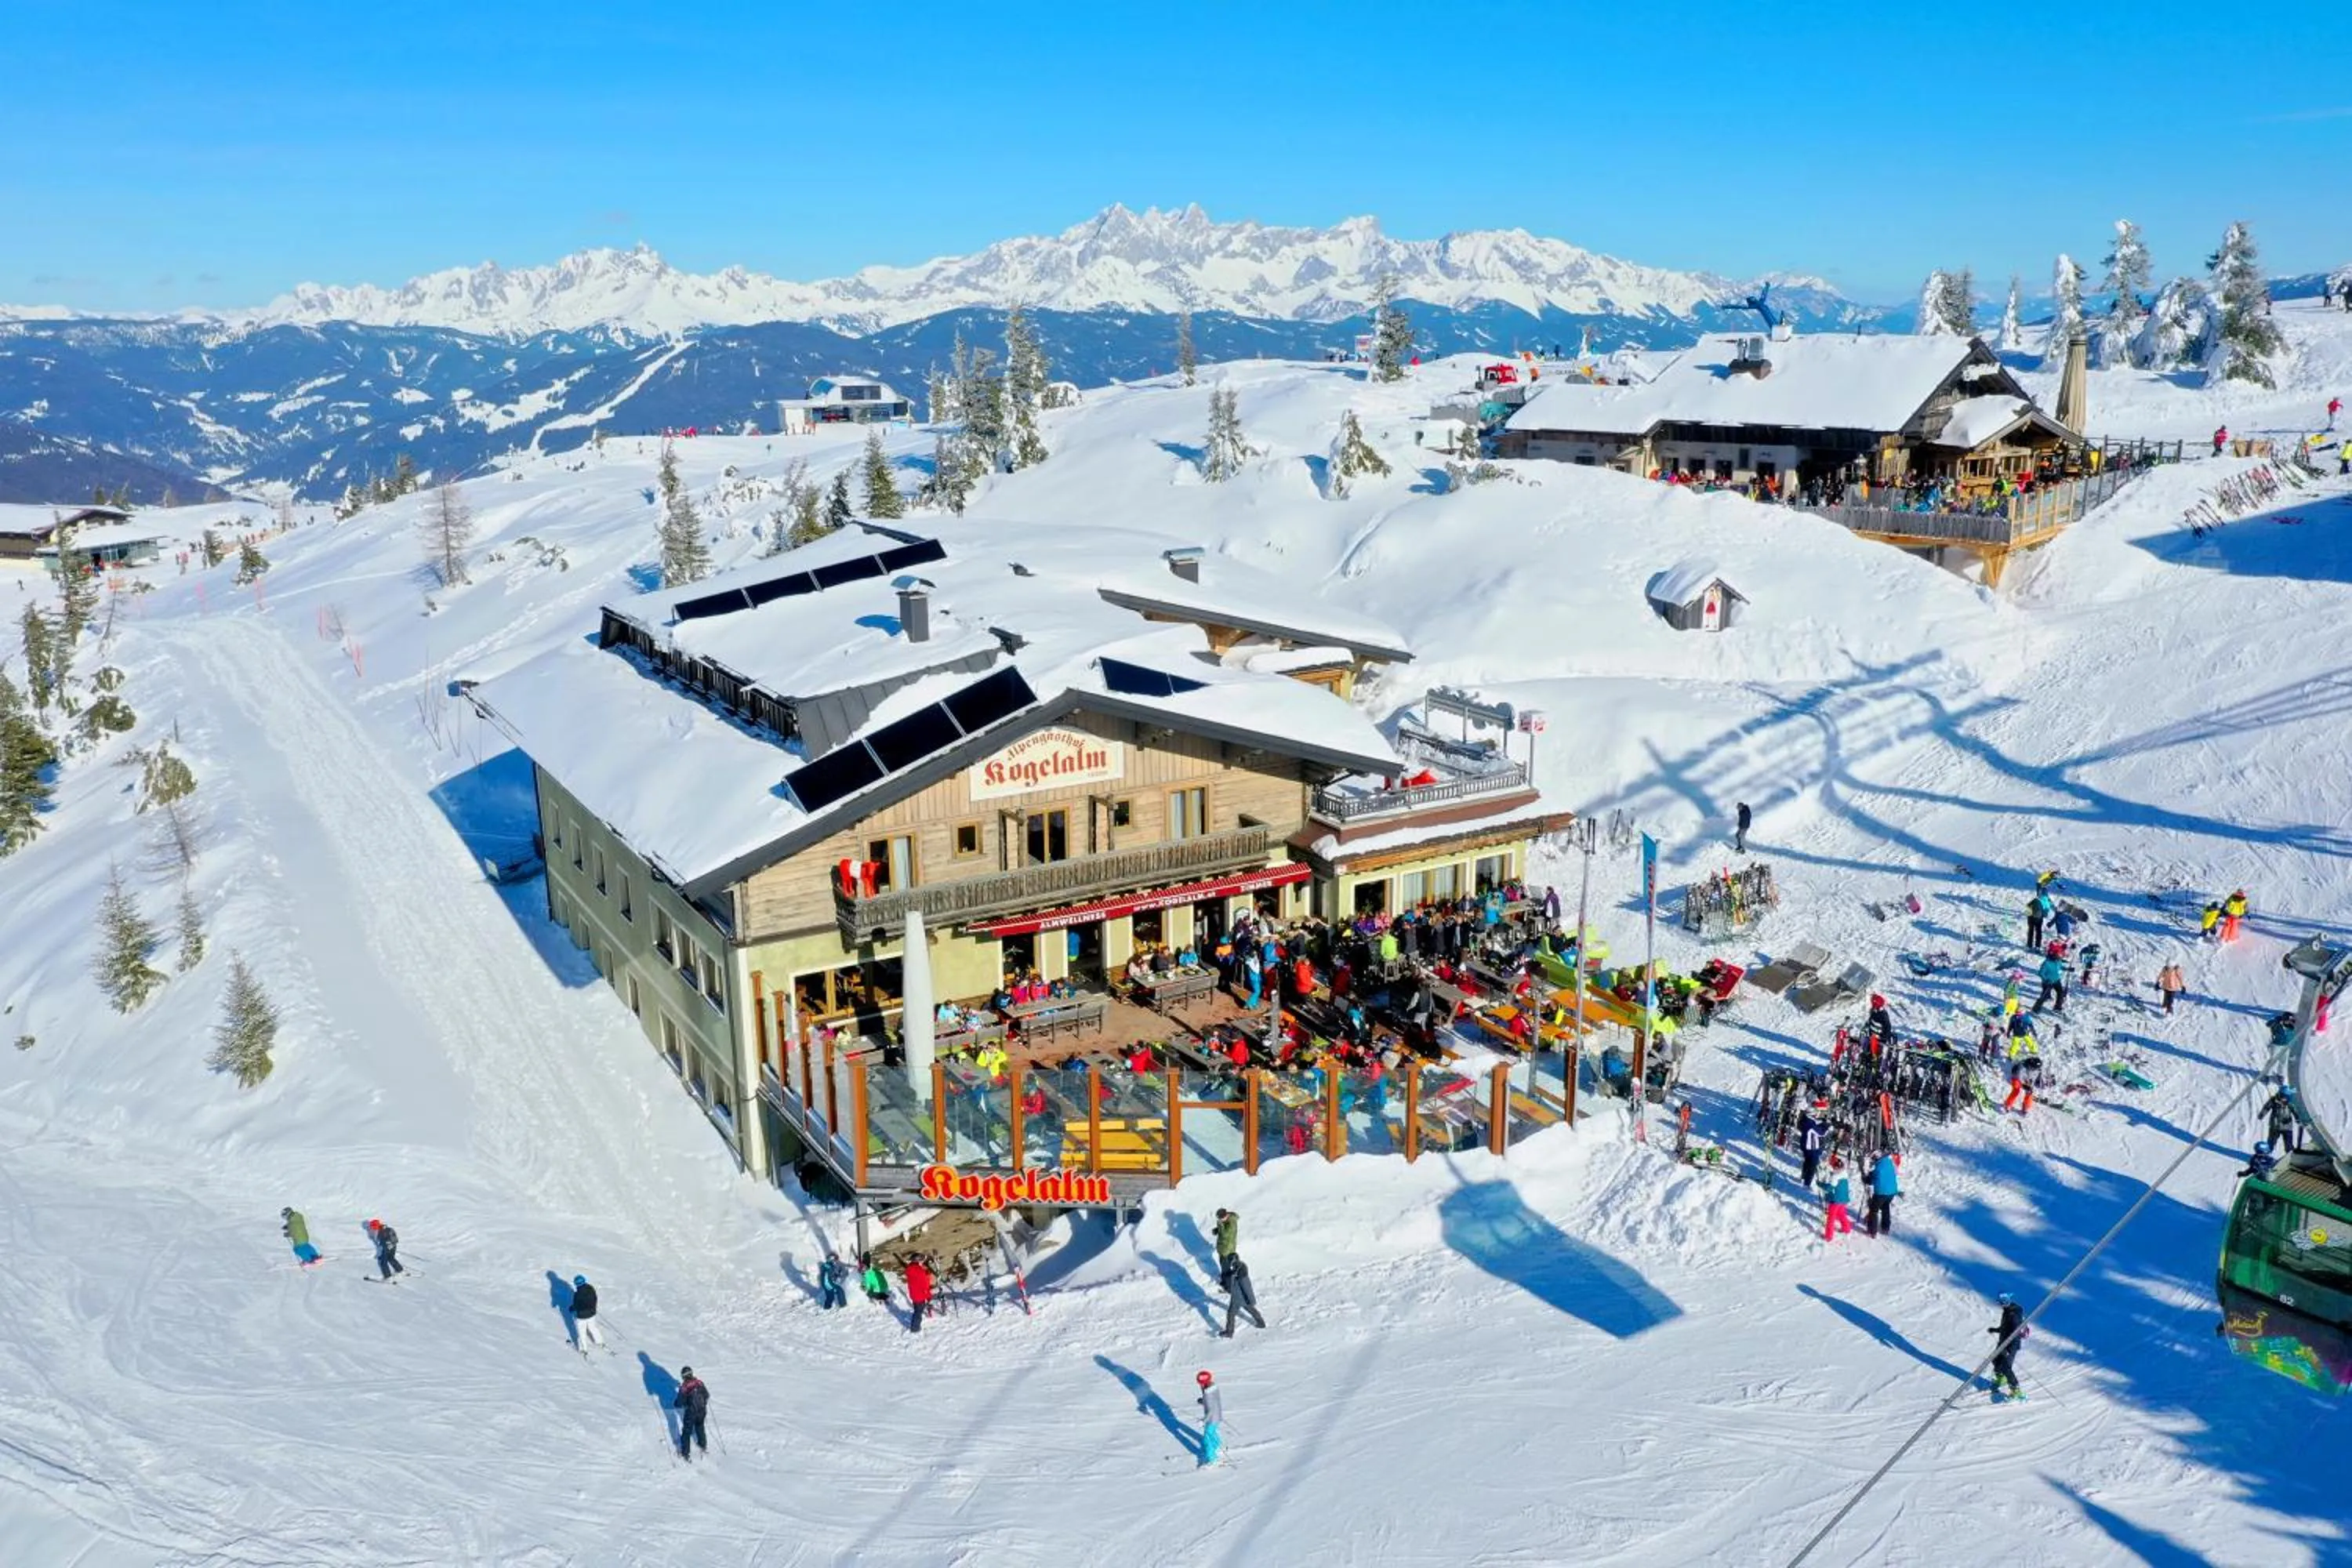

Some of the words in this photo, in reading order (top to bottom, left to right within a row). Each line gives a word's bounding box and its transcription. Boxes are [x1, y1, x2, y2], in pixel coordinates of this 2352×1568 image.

[984, 750, 1106, 786] Kogelalm
[1040, 910, 1106, 929] ALMWELLNESS
[920, 1163, 1111, 1211] Kogelalm
